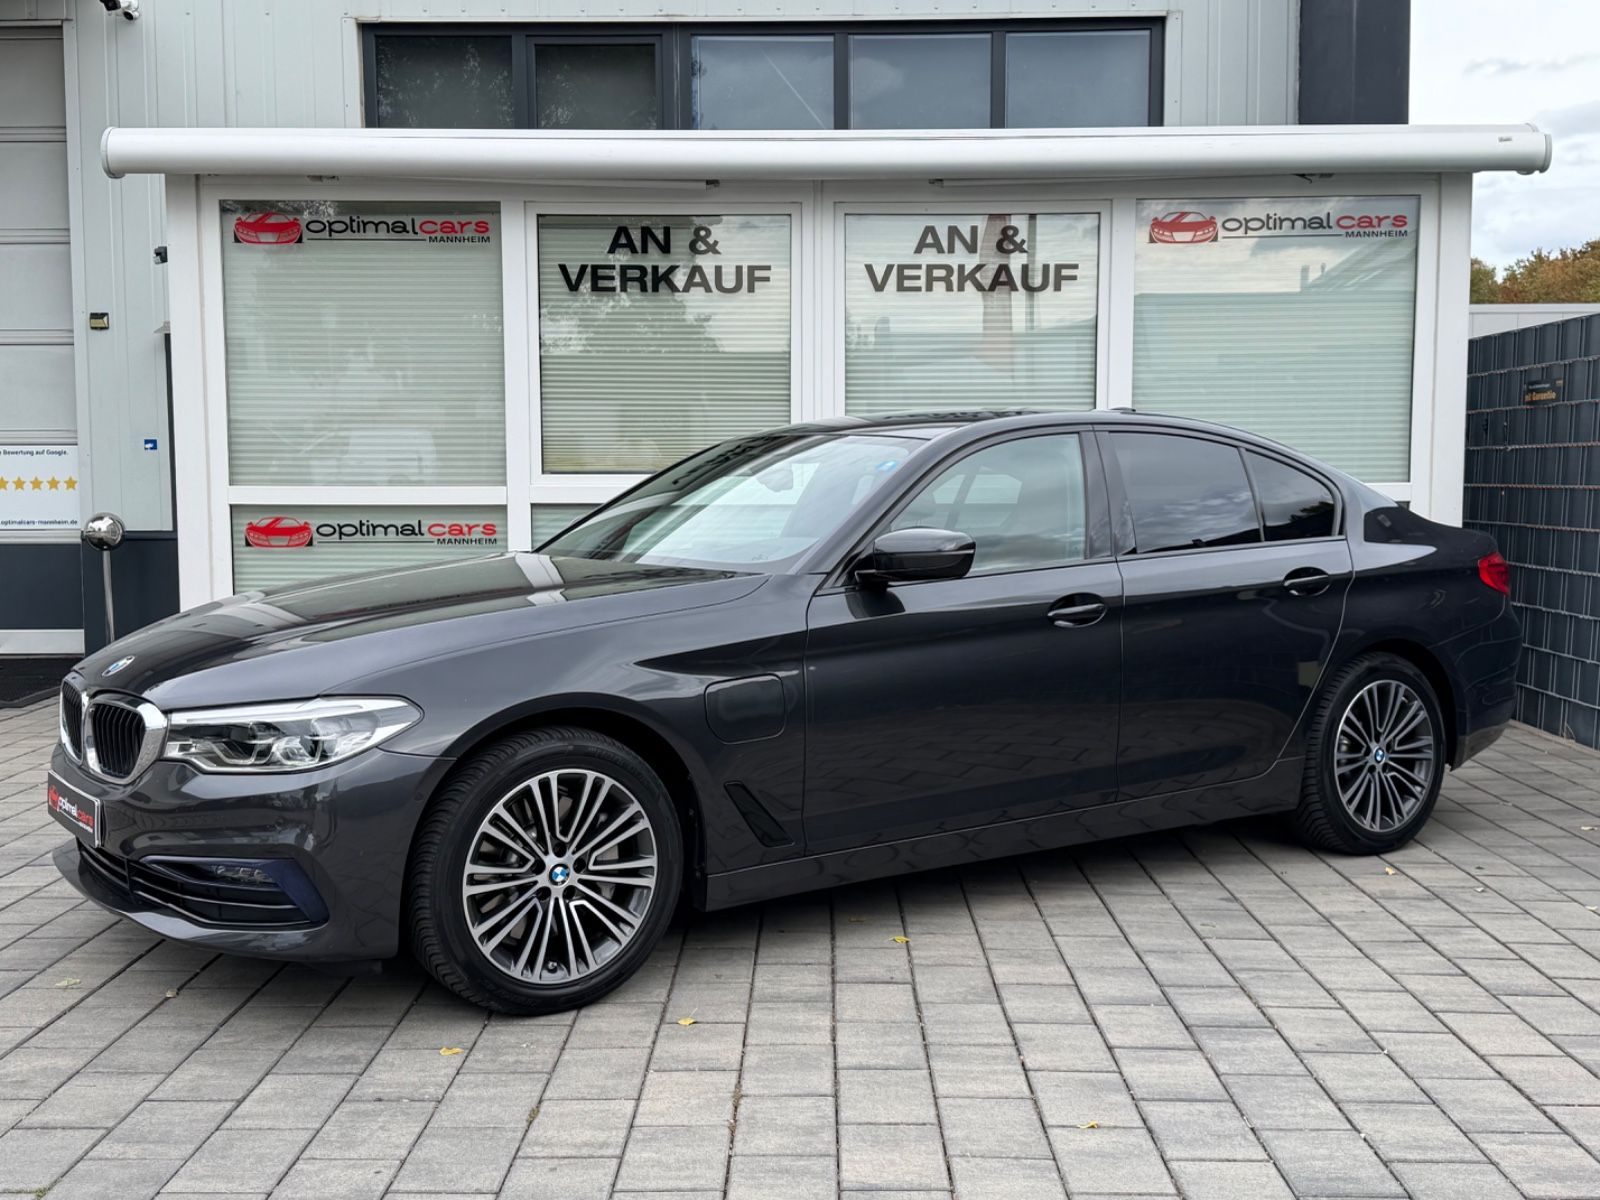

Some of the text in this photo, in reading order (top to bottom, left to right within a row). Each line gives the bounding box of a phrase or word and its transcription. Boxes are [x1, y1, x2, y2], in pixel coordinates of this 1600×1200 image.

[428, 235, 491, 244] MANNHEIM
[607, 226, 722, 255] AN &
[913, 225, 1029, 254] AN &
[1345, 229, 1409, 239] MANNHEIM
[558, 263, 772, 293] VERKAUF
[864, 263, 1080, 292] VERKAUF
[436, 537, 498, 545] MANNHEIM
